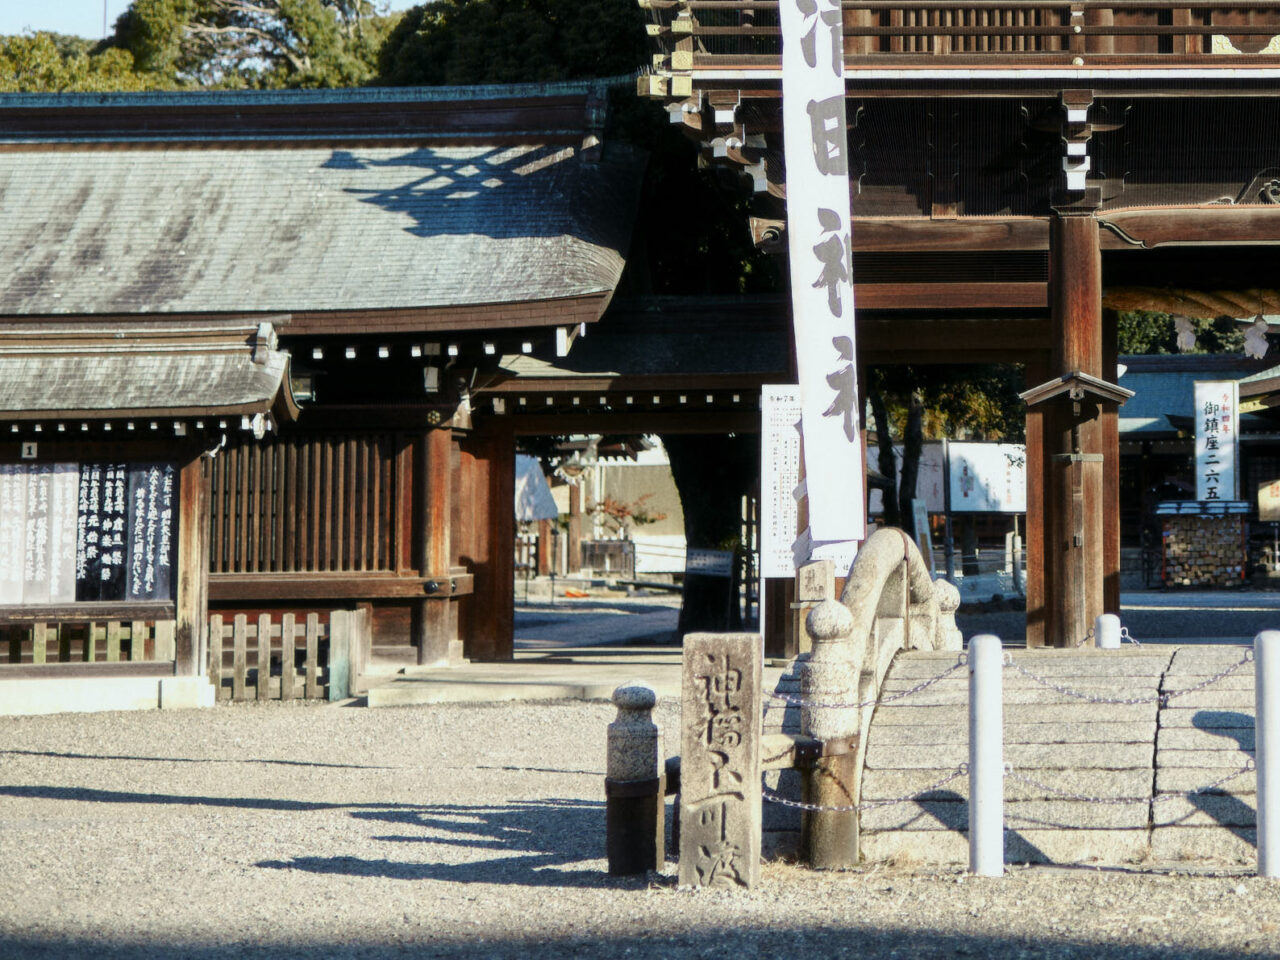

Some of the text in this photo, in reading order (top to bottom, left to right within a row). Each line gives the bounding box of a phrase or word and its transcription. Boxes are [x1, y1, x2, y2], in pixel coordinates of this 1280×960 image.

[26, 445, 34, 456] 1
[1203, 401, 1220, 501] 御鎮座二六五
